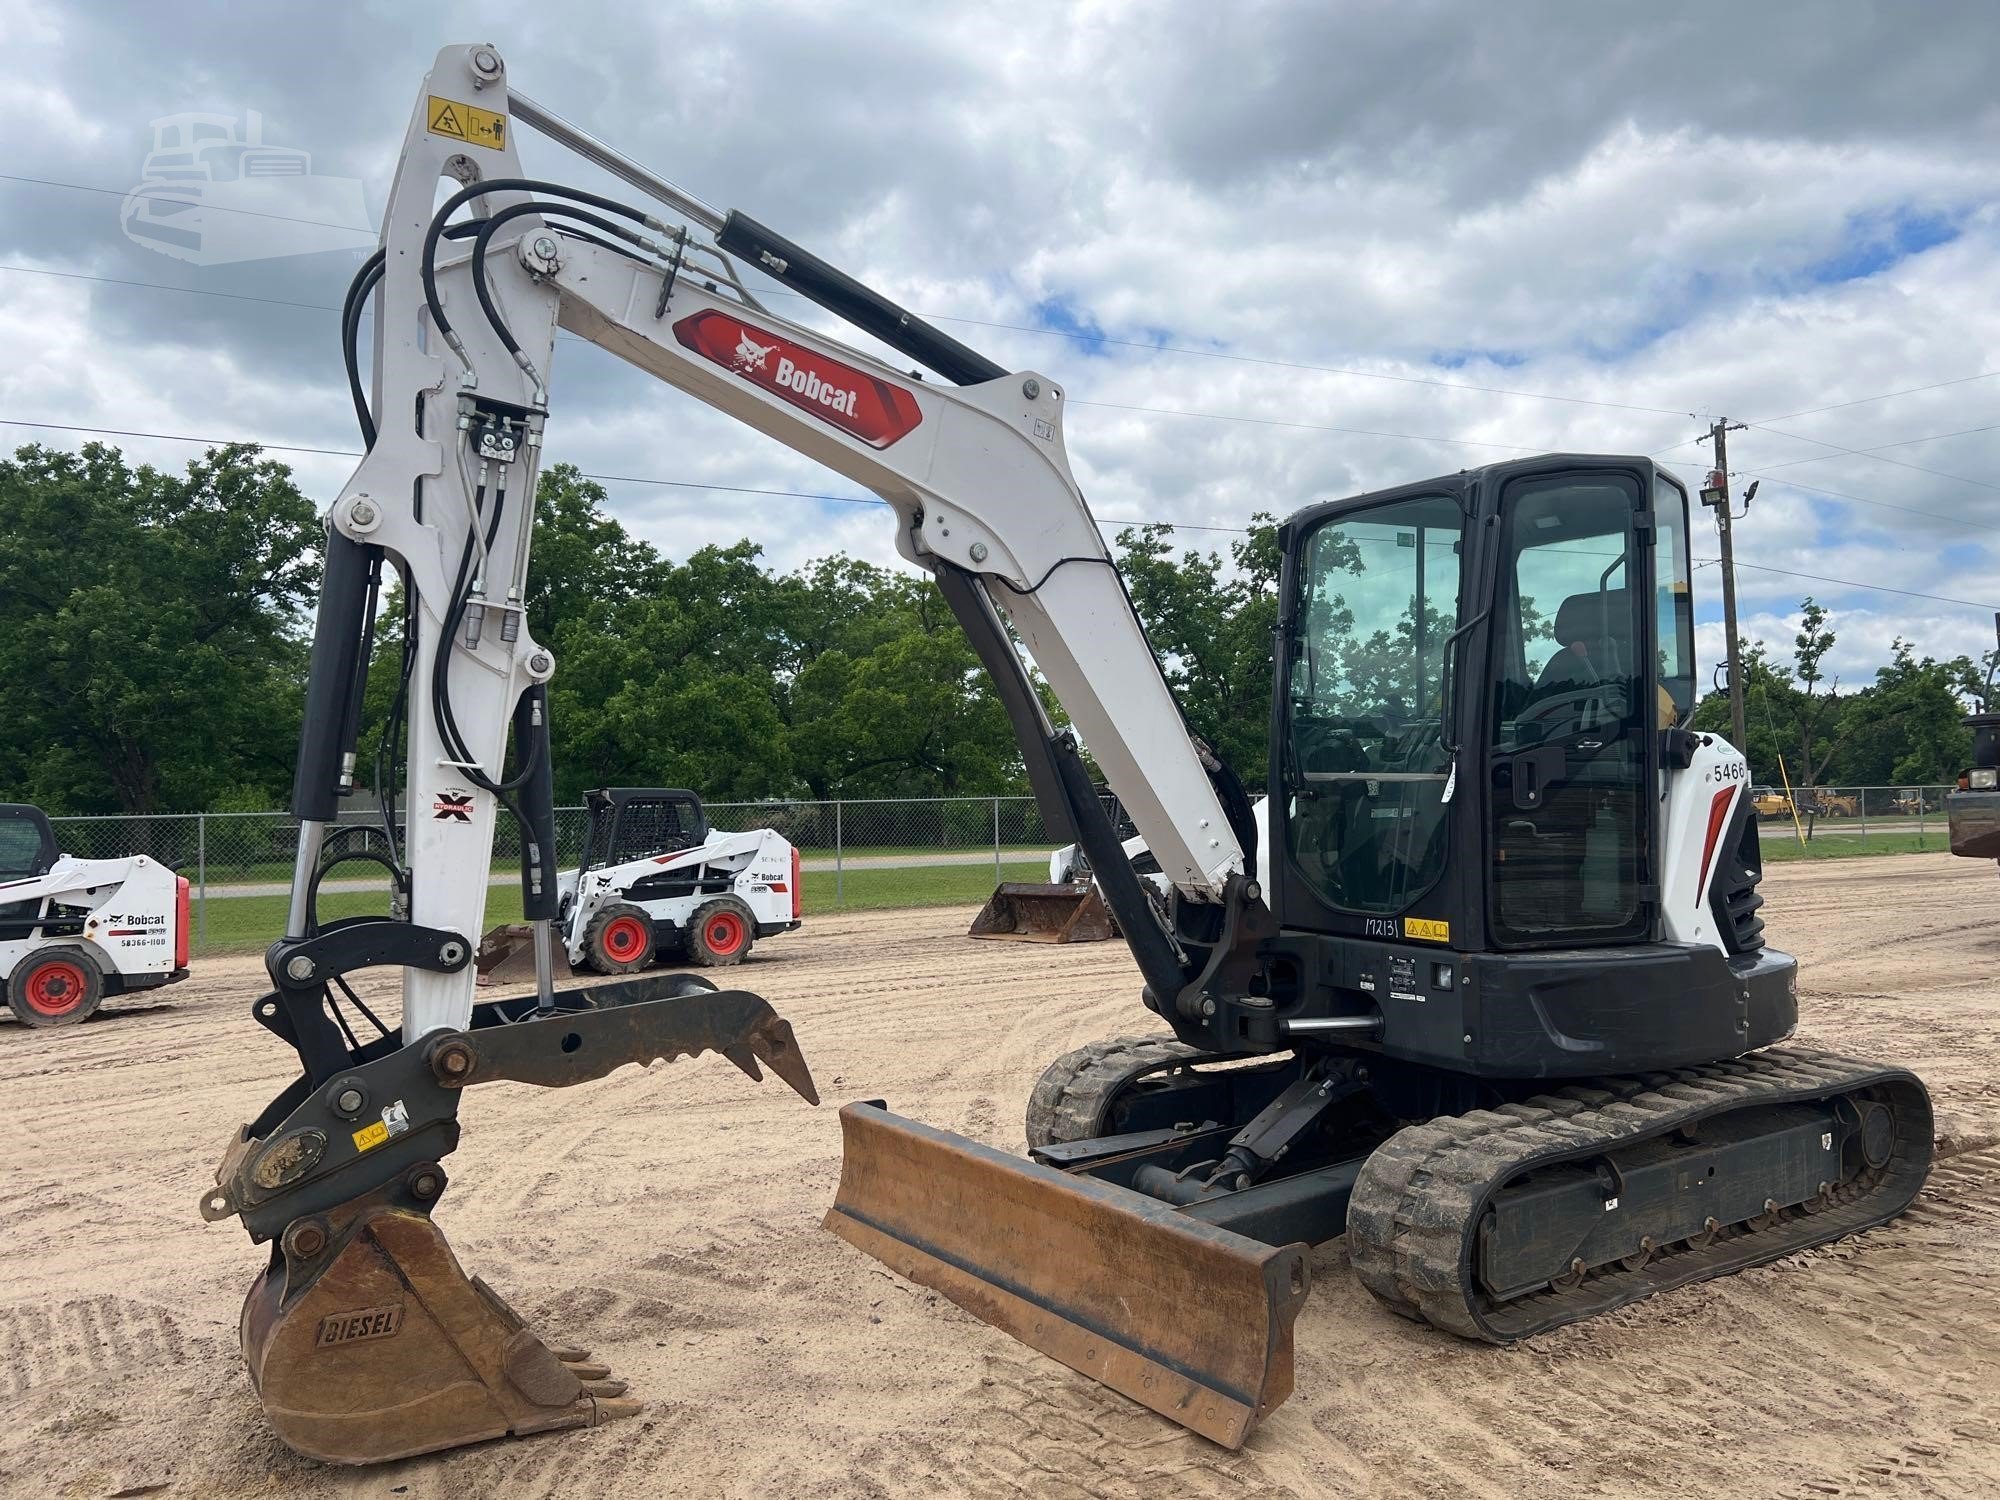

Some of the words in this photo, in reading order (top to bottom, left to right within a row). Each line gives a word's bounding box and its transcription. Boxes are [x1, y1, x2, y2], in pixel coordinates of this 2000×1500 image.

[774, 357, 857, 418] Bobcat
[1714, 761, 1745, 782] 5466
[434, 803, 473, 812] HYDRAULIC
[761, 873, 784, 881] Bobcat
[127, 914, 165, 926] Bobcat
[324, 1312, 393, 1343] DIESEL
